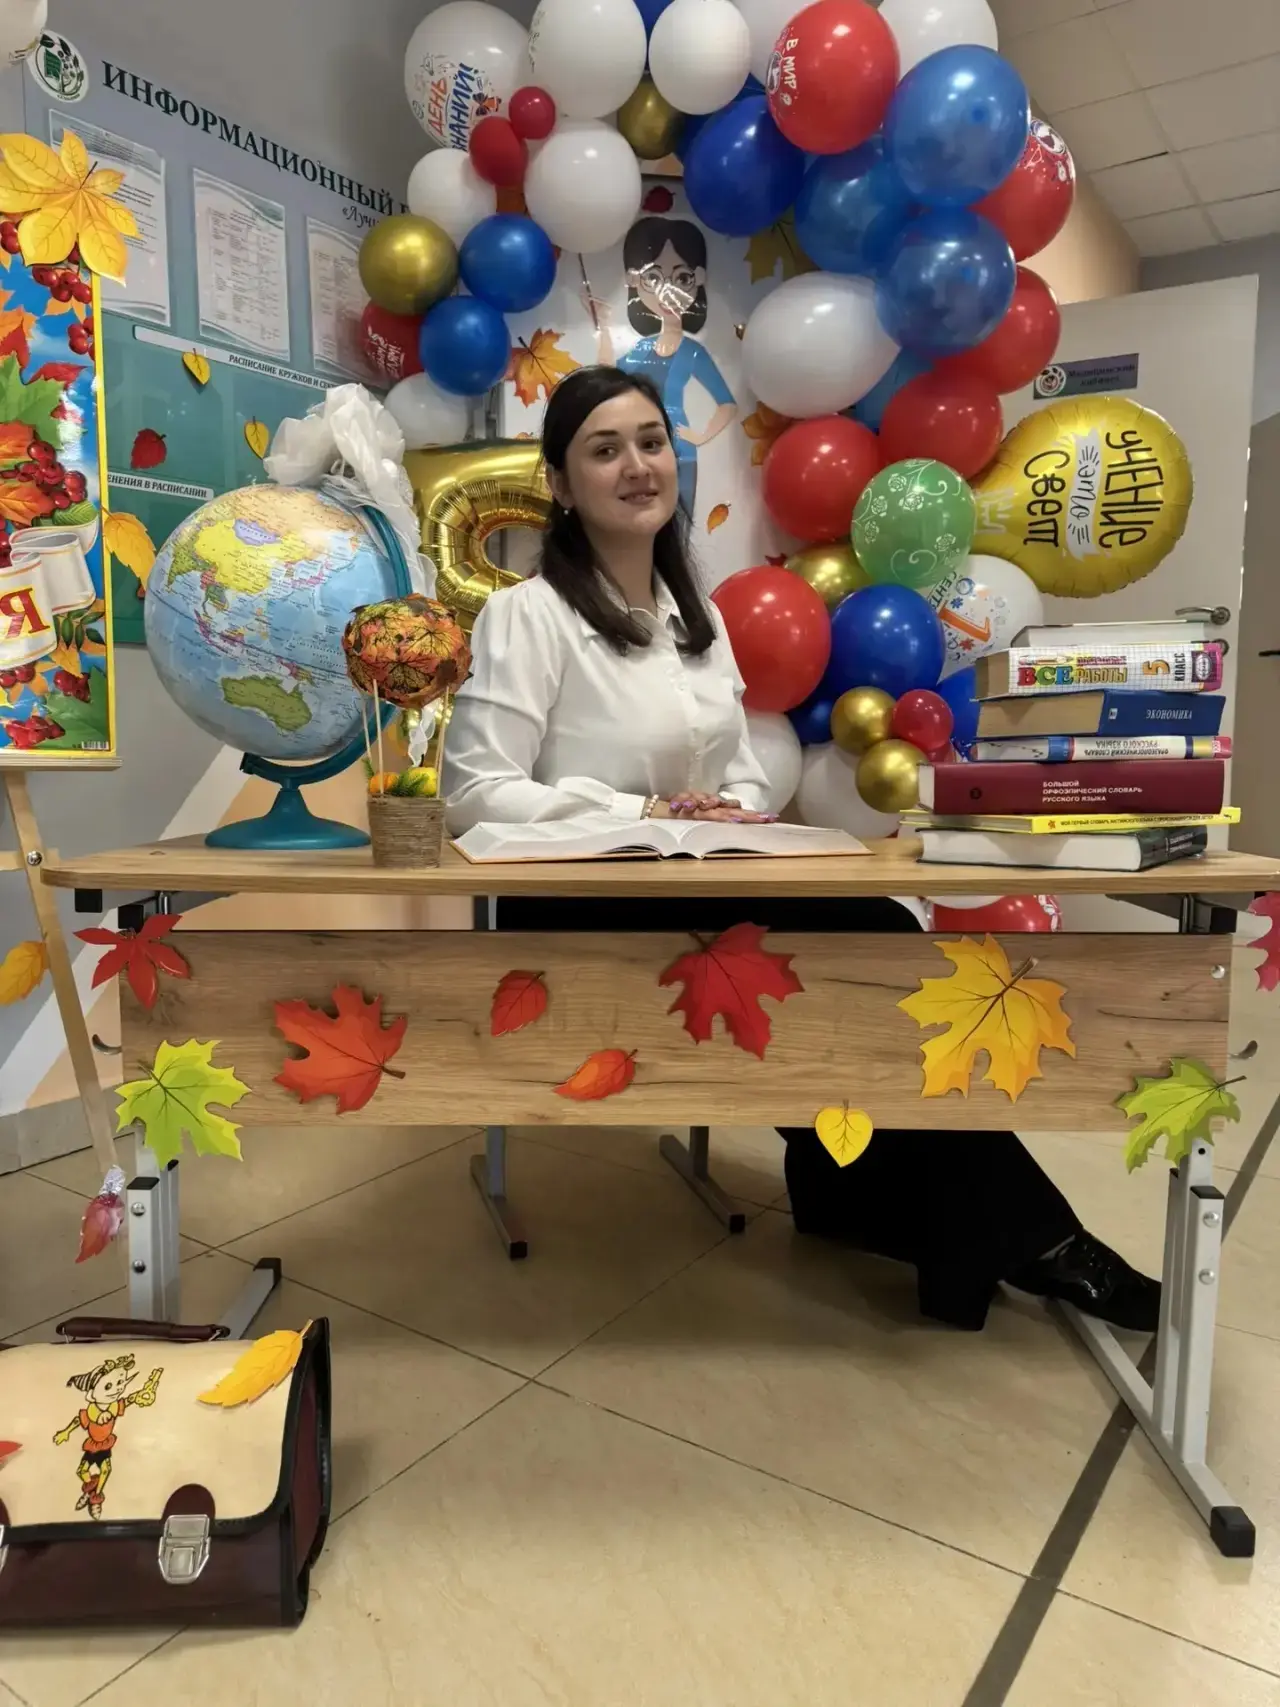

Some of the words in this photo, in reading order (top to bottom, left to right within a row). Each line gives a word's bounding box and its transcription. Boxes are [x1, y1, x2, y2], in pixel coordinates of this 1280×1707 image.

[785, 38, 799, 52] В
[783, 56, 797, 90] МИР
[427, 77, 448, 137] ДЕНЬ
[101, 60, 394, 216] ИНФОРМАЦИОННЫЙ
[229, 354, 277, 375] РАСПИСАНИЕ
[278, 368, 313, 386] КРУЖКОВ
[313, 379, 320, 387] И
[144, 480, 151, 489] В
[152, 482, 208, 498] РАСПИСАНИИ
[937, 599, 992, 644] 1
[1017, 665, 1074, 686] ВСЕ
[1075, 667, 1128, 684] РАБОТЫ
[1142, 659, 1171, 675] 5
[1174, 652, 1186, 682] КЛАСС
[1145, 708, 1193, 720] ЭКОНОМИКА
[1095, 739, 1121, 749] ЯЗЫКА
[1124, 739, 1158, 749] РУССКОГО
[1042, 780, 1080, 788] БОЛЬШОЙ
[1042, 787, 1107, 795] ОРФОЭПИЧЕСКИЙ
